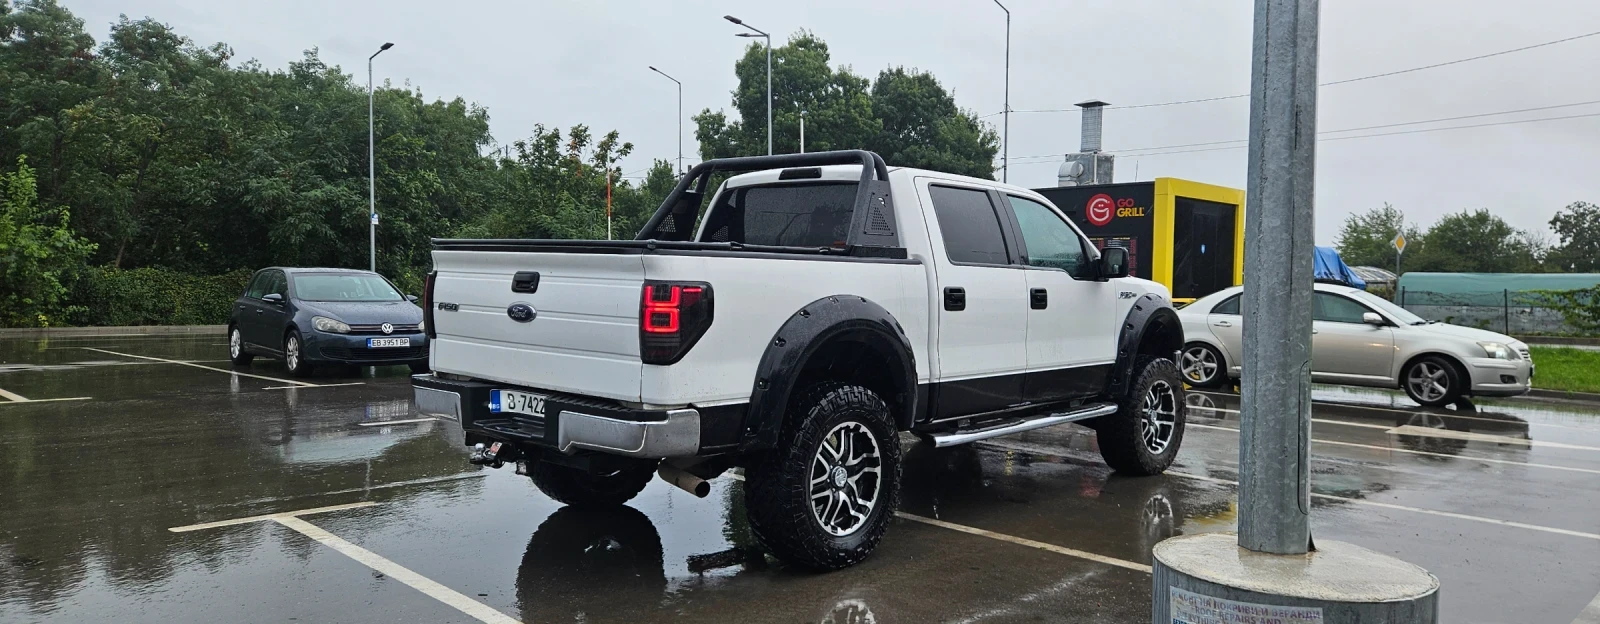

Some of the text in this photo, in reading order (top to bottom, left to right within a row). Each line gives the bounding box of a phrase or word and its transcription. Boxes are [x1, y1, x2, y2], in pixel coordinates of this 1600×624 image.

[1117, 198, 1134, 207] GO
[1116, 207, 1145, 217] GRILL
[510, 306, 528, 318] Ford
[372, 338, 409, 347] EB 3951 BP
[1219, 611, 1257, 624] REPAIRS
